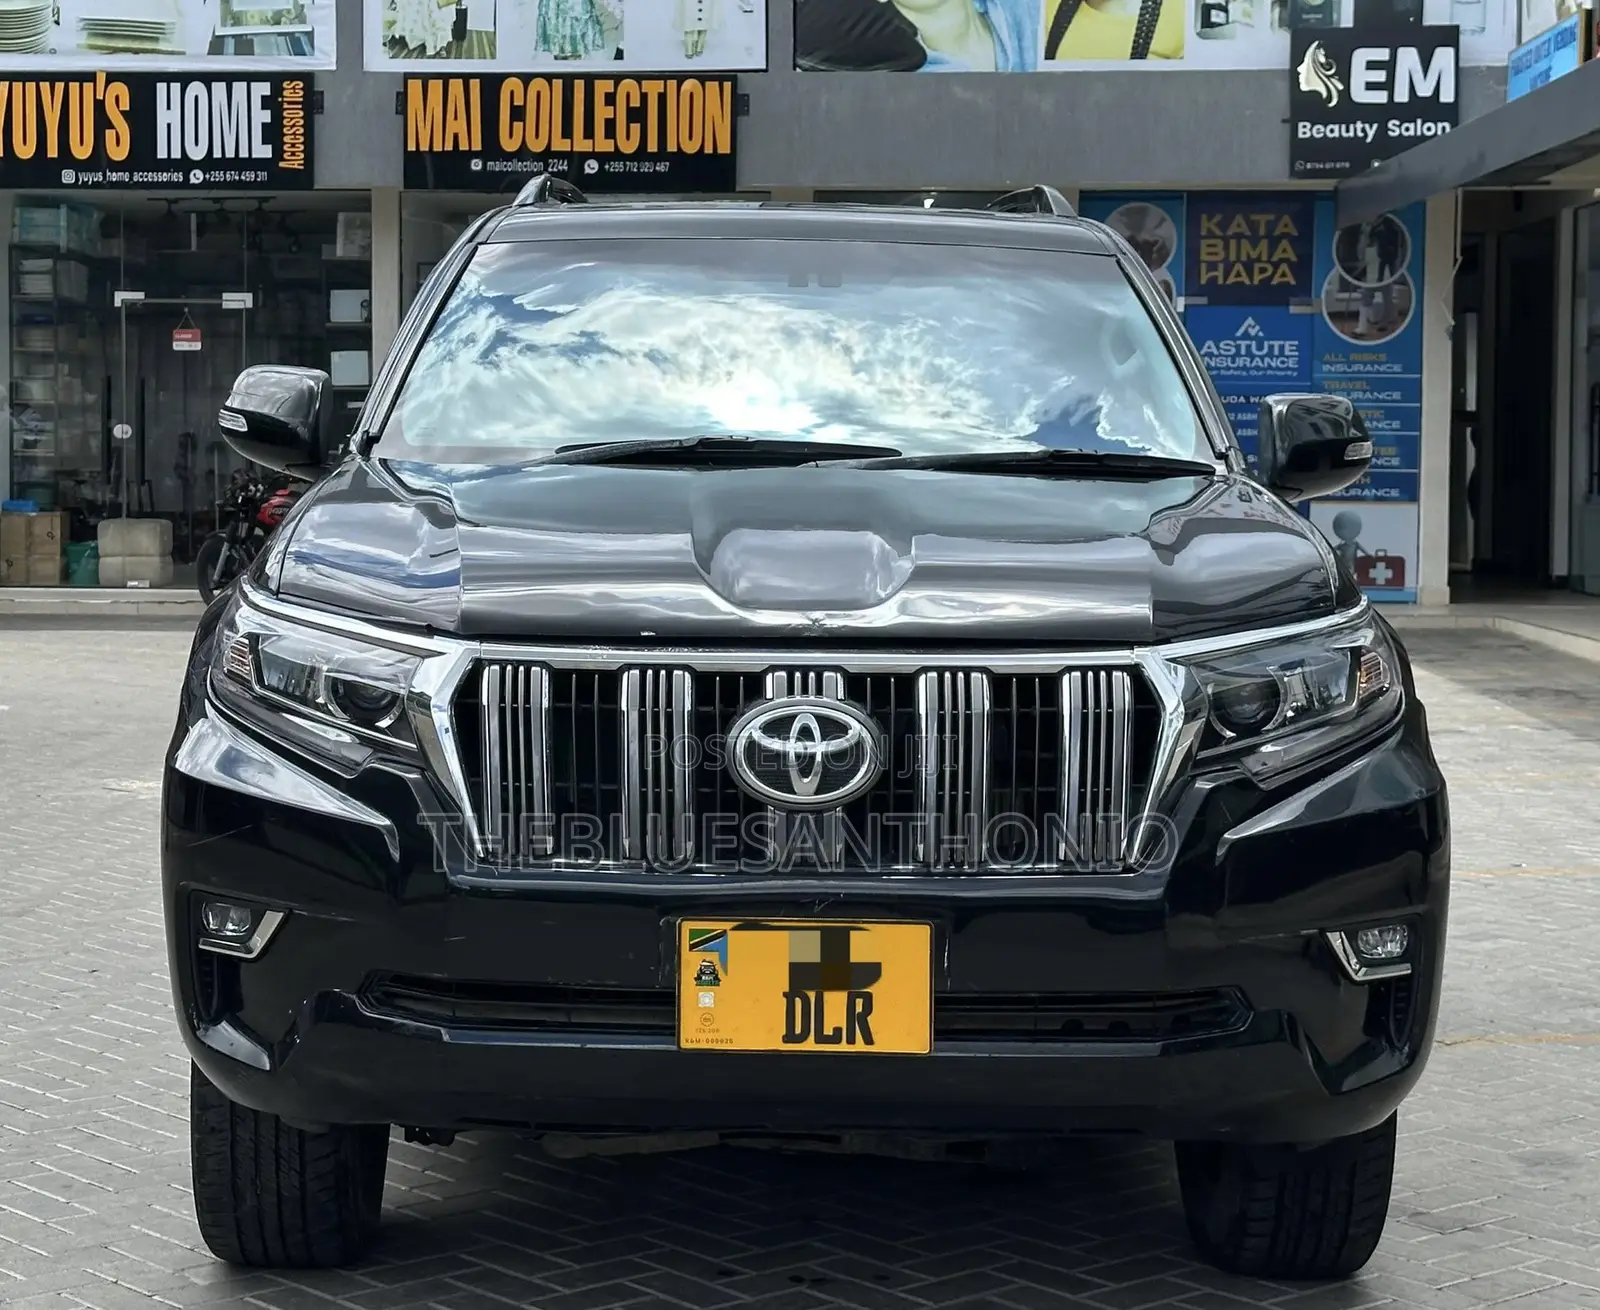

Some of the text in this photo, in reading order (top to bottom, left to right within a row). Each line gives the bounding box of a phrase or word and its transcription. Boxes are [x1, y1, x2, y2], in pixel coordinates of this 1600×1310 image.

[1350, 46, 1455, 104] EM
[155, 81, 272, 161] HOME
[278, 80, 305, 170] Accessories
[407, 77, 732, 154] MAI COLLECTION
[1297, 118, 1451, 144] Beauty Salon
[77, 168, 184, 185] yuyus_home_accessories
[204, 170, 268, 183] +255 674 459 311
[604, 160, 625, 173] +255
[626, 160, 638, 173] 712
[1200, 213, 1299, 237] KATA
[1200, 239, 1298, 262] BIMA
[1200, 263, 1297, 286] HAPA
[1201, 340, 1299, 355] ASTUTE
[1203, 357, 1299, 368] NSURANCE
[1322, 364, 1403, 372] INSURANCE
[782, 990, 875, 1046] DLR
